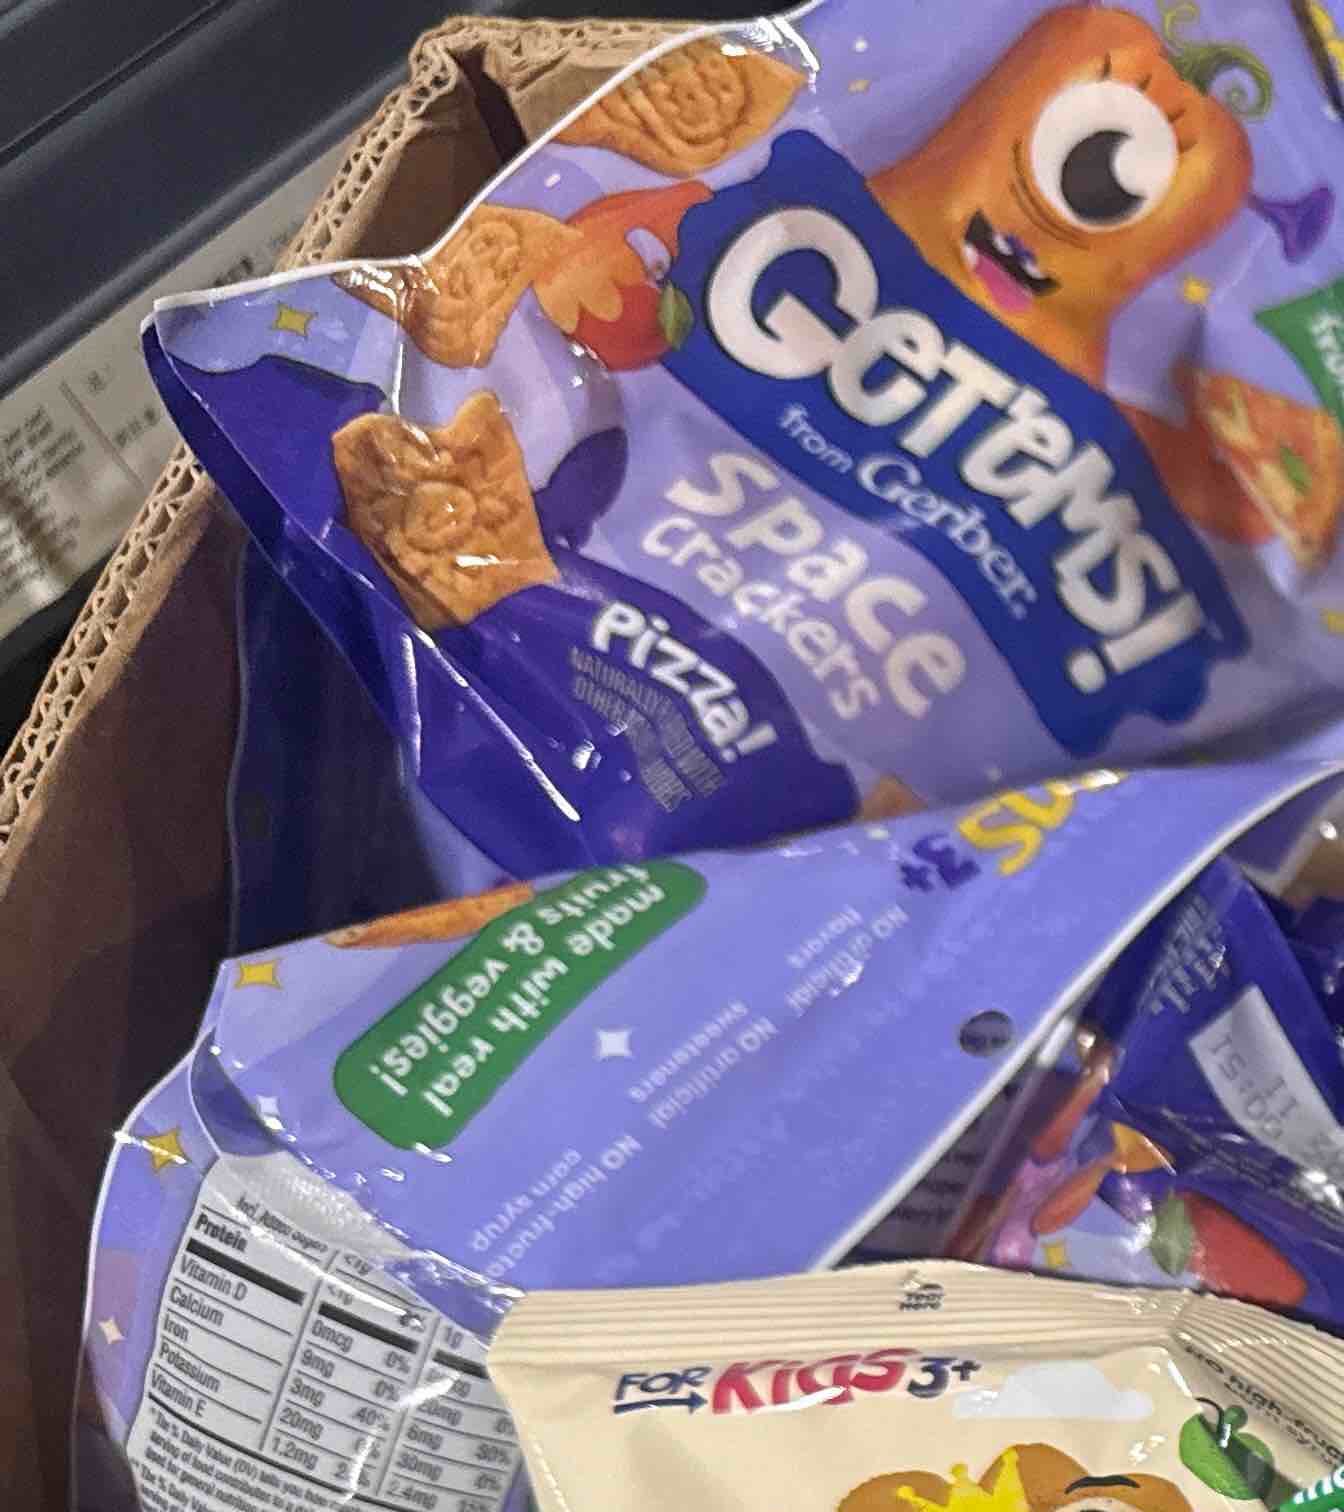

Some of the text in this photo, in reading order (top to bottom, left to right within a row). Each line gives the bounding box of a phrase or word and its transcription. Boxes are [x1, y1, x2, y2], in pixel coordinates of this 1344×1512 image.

[421, 880, 667, 1119] made with real
[366, 956, 507, 1099] veggies!
[180, 1254, 232, 1295] Vitamin
[163, 1313, 190, 1342] Iron
[170, 1284, 225, 1327] Calcium
[159, 1341, 222, 1392] Potassium
[614, 1362, 712, 1402] FOR
[150, 1368, 195, 1412] Vitamin
[270, 1436, 319, 1471] 1.2mg
